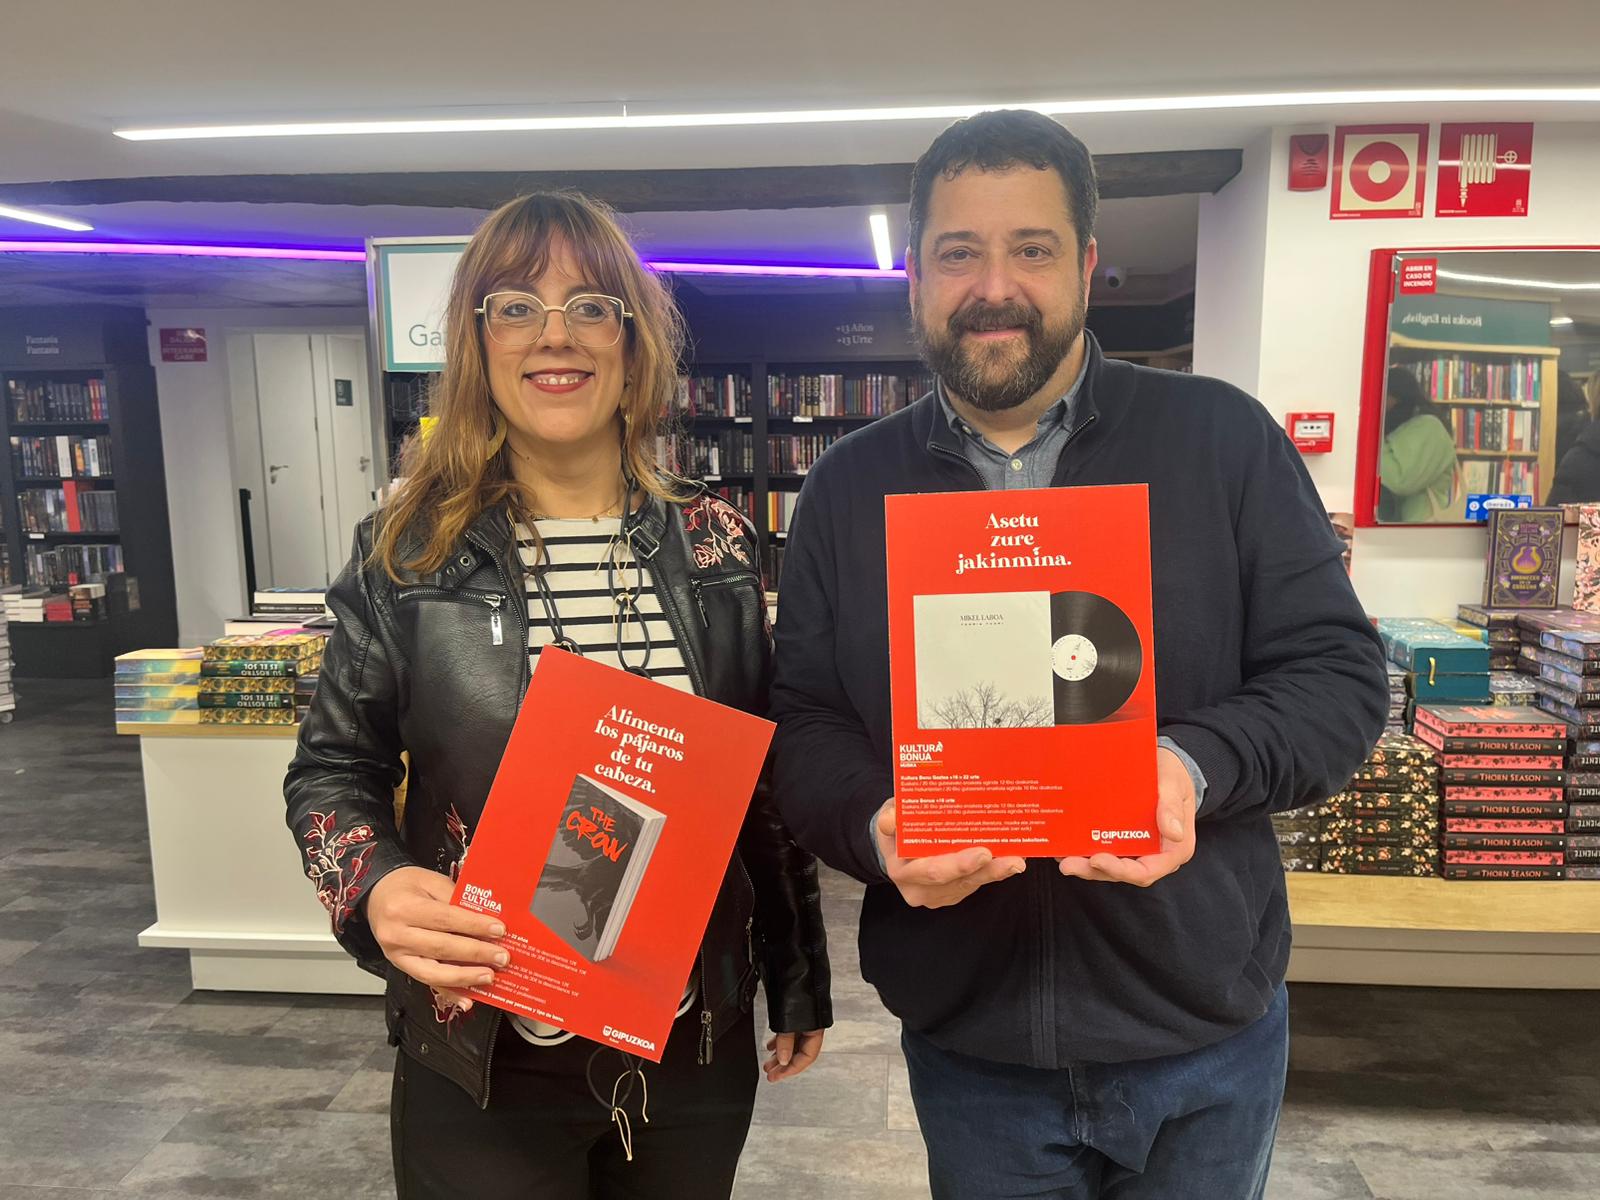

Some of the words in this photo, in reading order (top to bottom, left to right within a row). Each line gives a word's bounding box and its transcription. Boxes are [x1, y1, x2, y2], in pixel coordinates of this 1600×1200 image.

[985, 512, 1040, 529] Asetu
[990, 532, 1035, 547] zure
[955, 546, 1072, 575] jakinmina.
[604, 705, 685, 744] Alimenta
[594, 719, 618, 739] los
[620, 730, 684, 762] pájaros
[900, 742, 943, 752] KULTURA
[610, 748, 630, 765] de
[635, 756, 654, 774] tu
[900, 752, 932, 760] BONUA
[594, 763, 656, 794] cabeza.
[1510, 773, 1541, 781] SEASON
[590, 806, 616, 832] THE
[566, 811, 628, 862] CROW
[1101, 830, 1150, 839] GIPUZKOA
[1511, 870, 1542, 878] SEASON
[465, 884, 490, 898] BONO
[462, 892, 502, 912] CULTURA
[612, 1030, 655, 1051] GIPUZKOA
